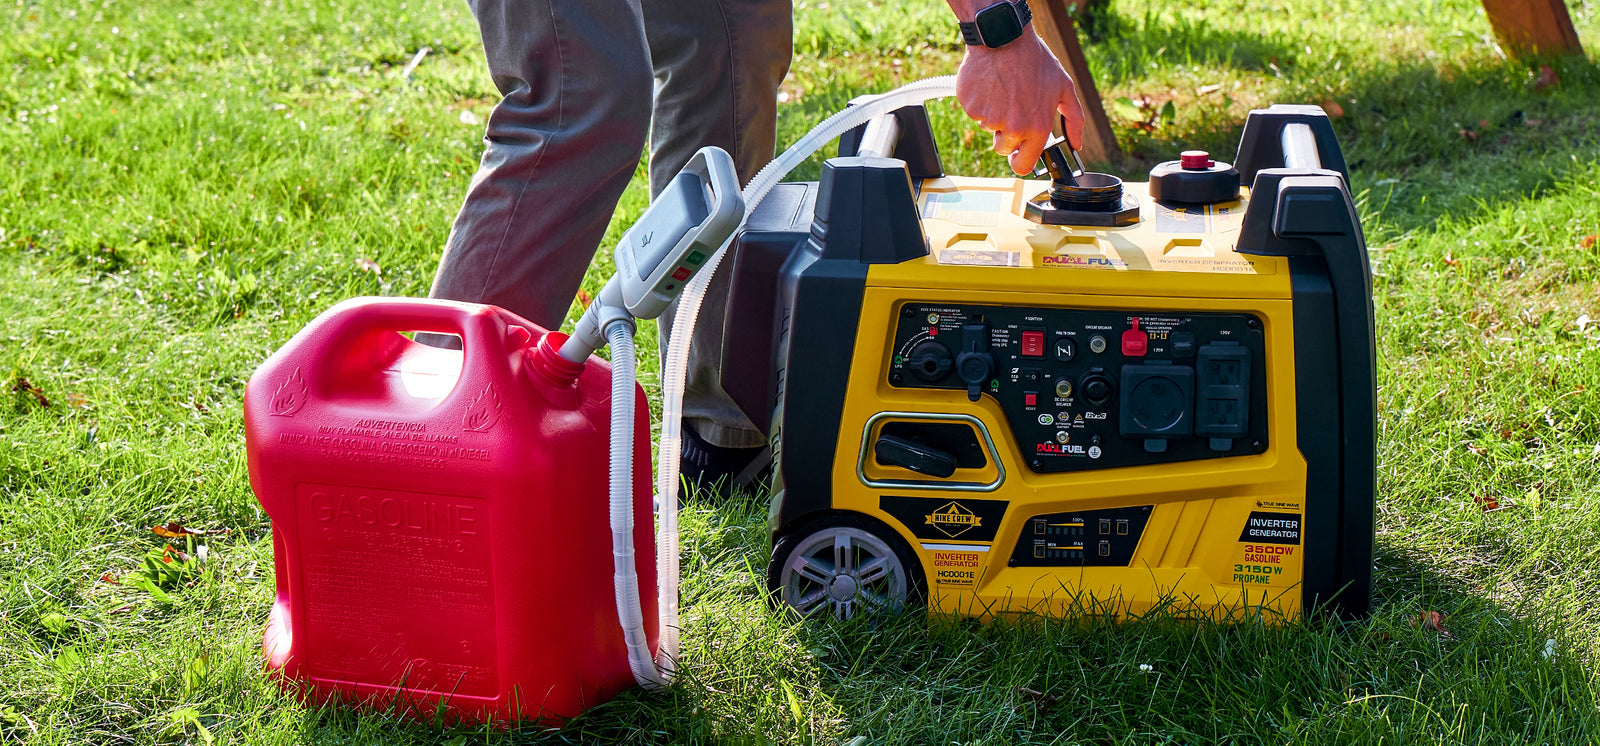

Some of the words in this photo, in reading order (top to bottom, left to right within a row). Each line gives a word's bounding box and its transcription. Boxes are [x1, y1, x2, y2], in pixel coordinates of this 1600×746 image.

[1043, 256, 1087, 264] DUAL
[355, 418, 426, 433] ADVERTENCIA
[317, 425, 336, 435] MUY
[411, 432, 422, 441] DE
[423, 434, 458, 445] LLAMAS
[280, 432, 310, 446] NUNCA
[312, 435, 330, 448] USE
[381, 441, 438, 457] QUEROSENO
[439, 446, 448, 458] ni
[449, 447, 458, 459] el
[459, 448, 491, 461] DIESEL
[1037, 444, 1062, 453] DUAL
[1062, 445, 1085, 453] FUEL
[309, 491, 478, 537] GASOLINE
[934, 514, 951, 523] HIKE
[952, 514, 972, 523] CREW
[1250, 518, 1299, 528] INVERTER
[1249, 528, 1298, 538] GENERATOR
[1244, 544, 1294, 555] 3500W
[935, 552, 979, 561] INVERTER
[1244, 553, 1281, 564] GASOLINE
[934, 560, 979, 568] GENERATOR
[1233, 574, 1270, 584] PROPANE
